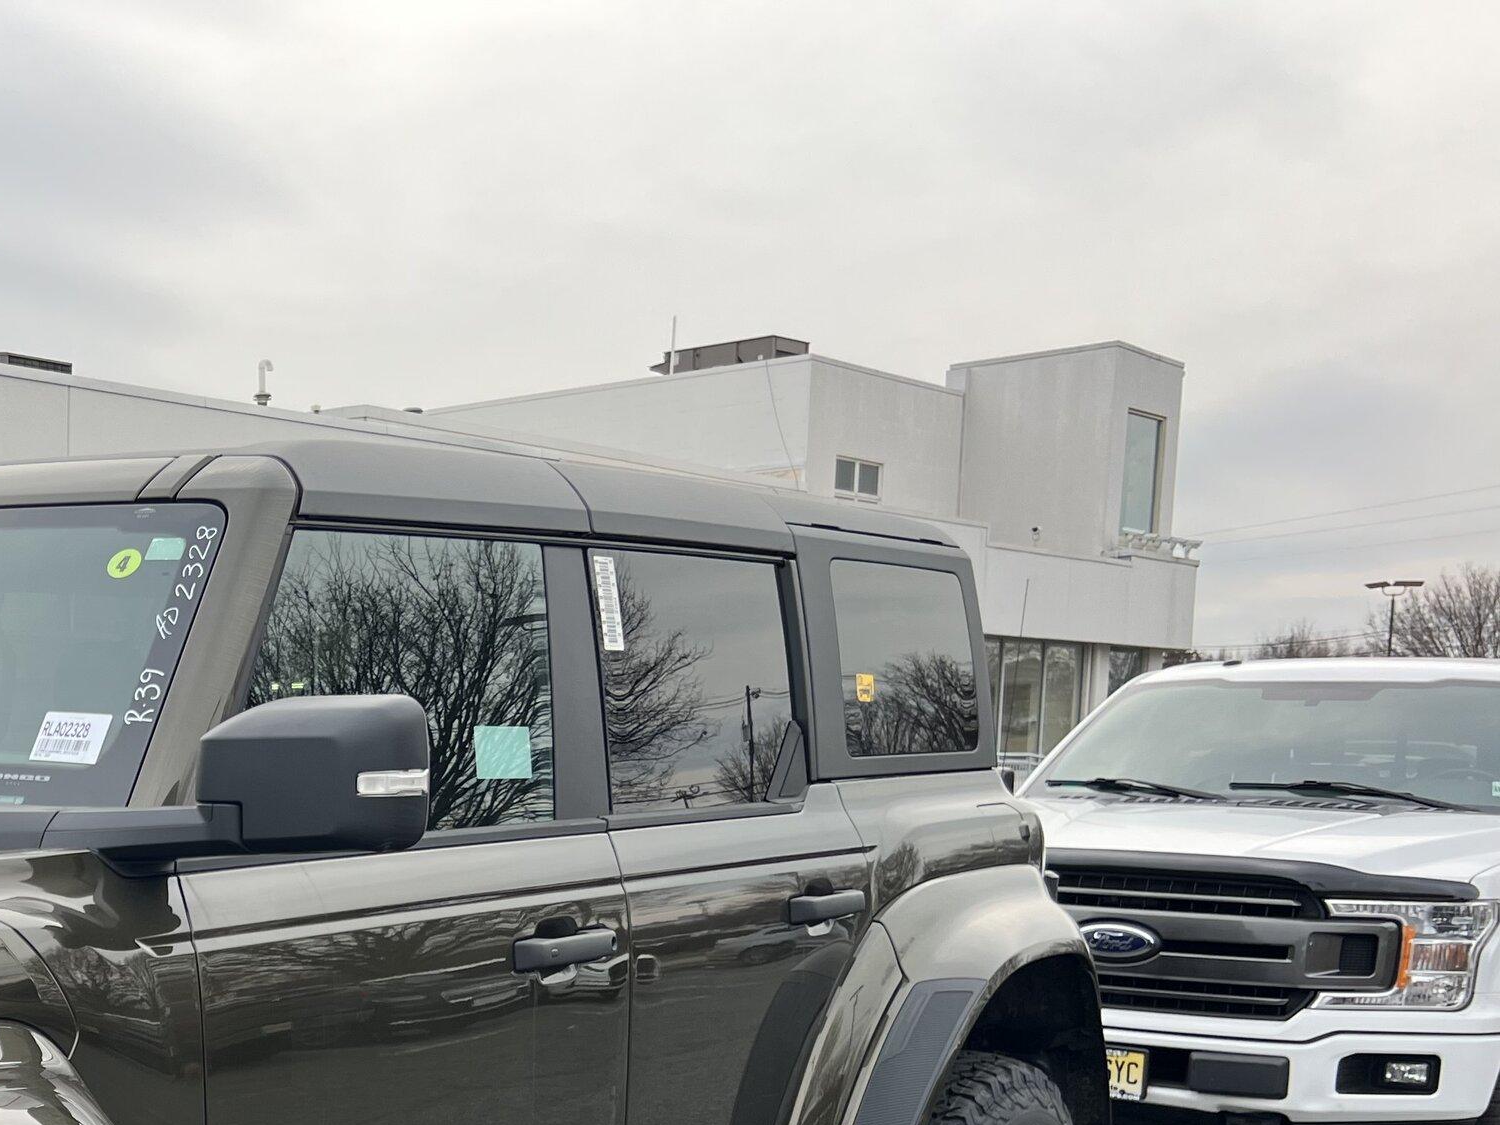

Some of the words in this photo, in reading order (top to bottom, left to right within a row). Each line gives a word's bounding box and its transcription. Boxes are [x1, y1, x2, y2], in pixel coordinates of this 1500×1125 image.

[116, 555, 131, 573] 4
[174, 526, 218, 600] 2328
[41, 721, 91, 738] RLA02328
